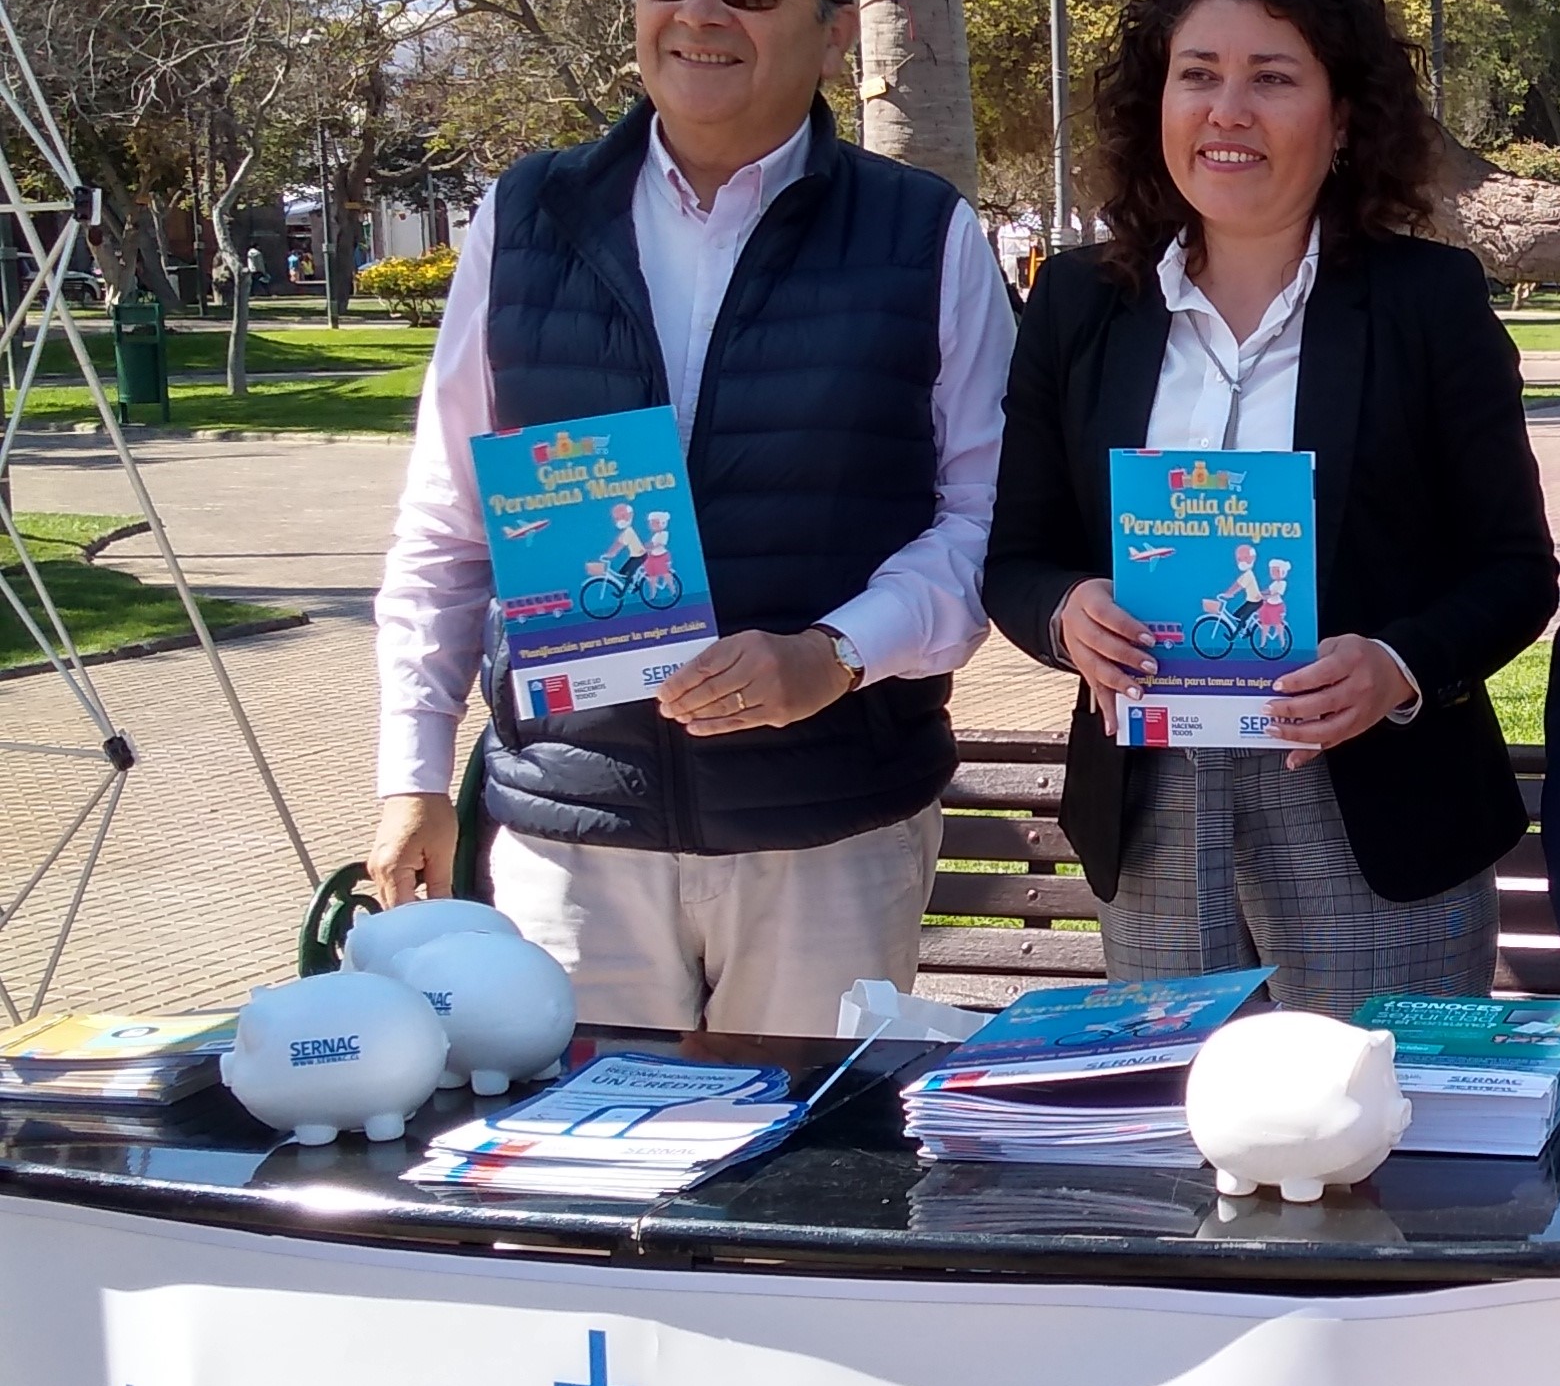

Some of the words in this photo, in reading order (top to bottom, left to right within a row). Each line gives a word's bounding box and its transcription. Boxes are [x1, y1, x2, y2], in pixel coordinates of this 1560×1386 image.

[537, 462, 589, 492] Guía
[593, 458, 619, 478] de
[489, 487, 583, 516] Personas
[584, 473, 677, 501] Mayores
[1169, 492, 1220, 518] Guía
[1224, 496, 1248, 515] de
[1119, 512, 1210, 536] Personas
[1214, 518, 1302, 544] Mayores
[579, 637, 603, 652] para
[603, 633, 631, 646] tomar
[631, 631, 644, 641] la
[642, 662, 688, 682] SERN
[1184, 678, 1206, 688] para
[1207, 676, 1235, 687] tomar
[1236, 677, 1246, 687] la
[1247, 678, 1273, 690] mejor
[1171, 715, 1189, 723] CHILE
[1171, 722, 1203, 730] HACEMOS
[289, 1034, 361, 1057] SERNAC
[1082, 1052, 1175, 1071] SERNAC
[1447, 1074, 1523, 1086] SERNAC
